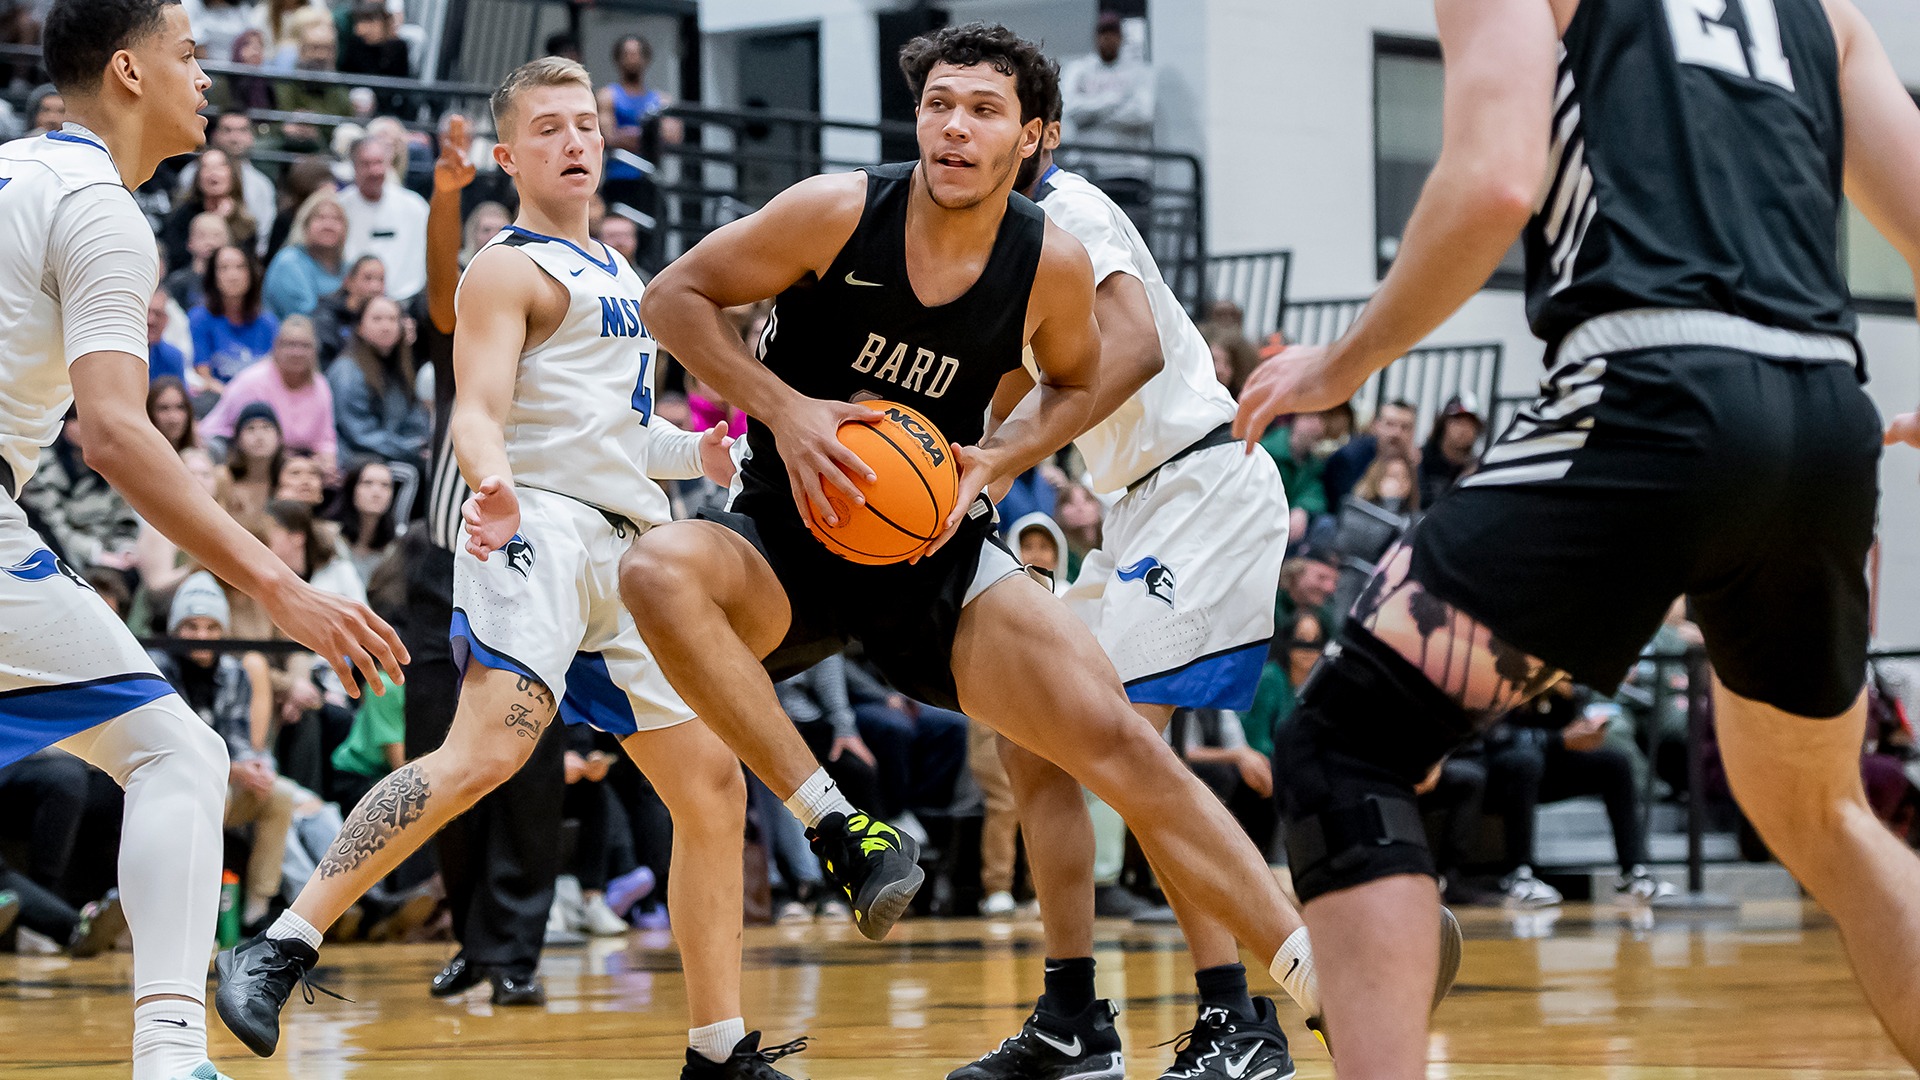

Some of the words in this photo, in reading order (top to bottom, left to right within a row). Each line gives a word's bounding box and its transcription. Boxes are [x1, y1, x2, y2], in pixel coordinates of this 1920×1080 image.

[631, 352, 652, 428] 4
[851, 332, 960, 398] BARD
[884, 408, 945, 467] NCAA
